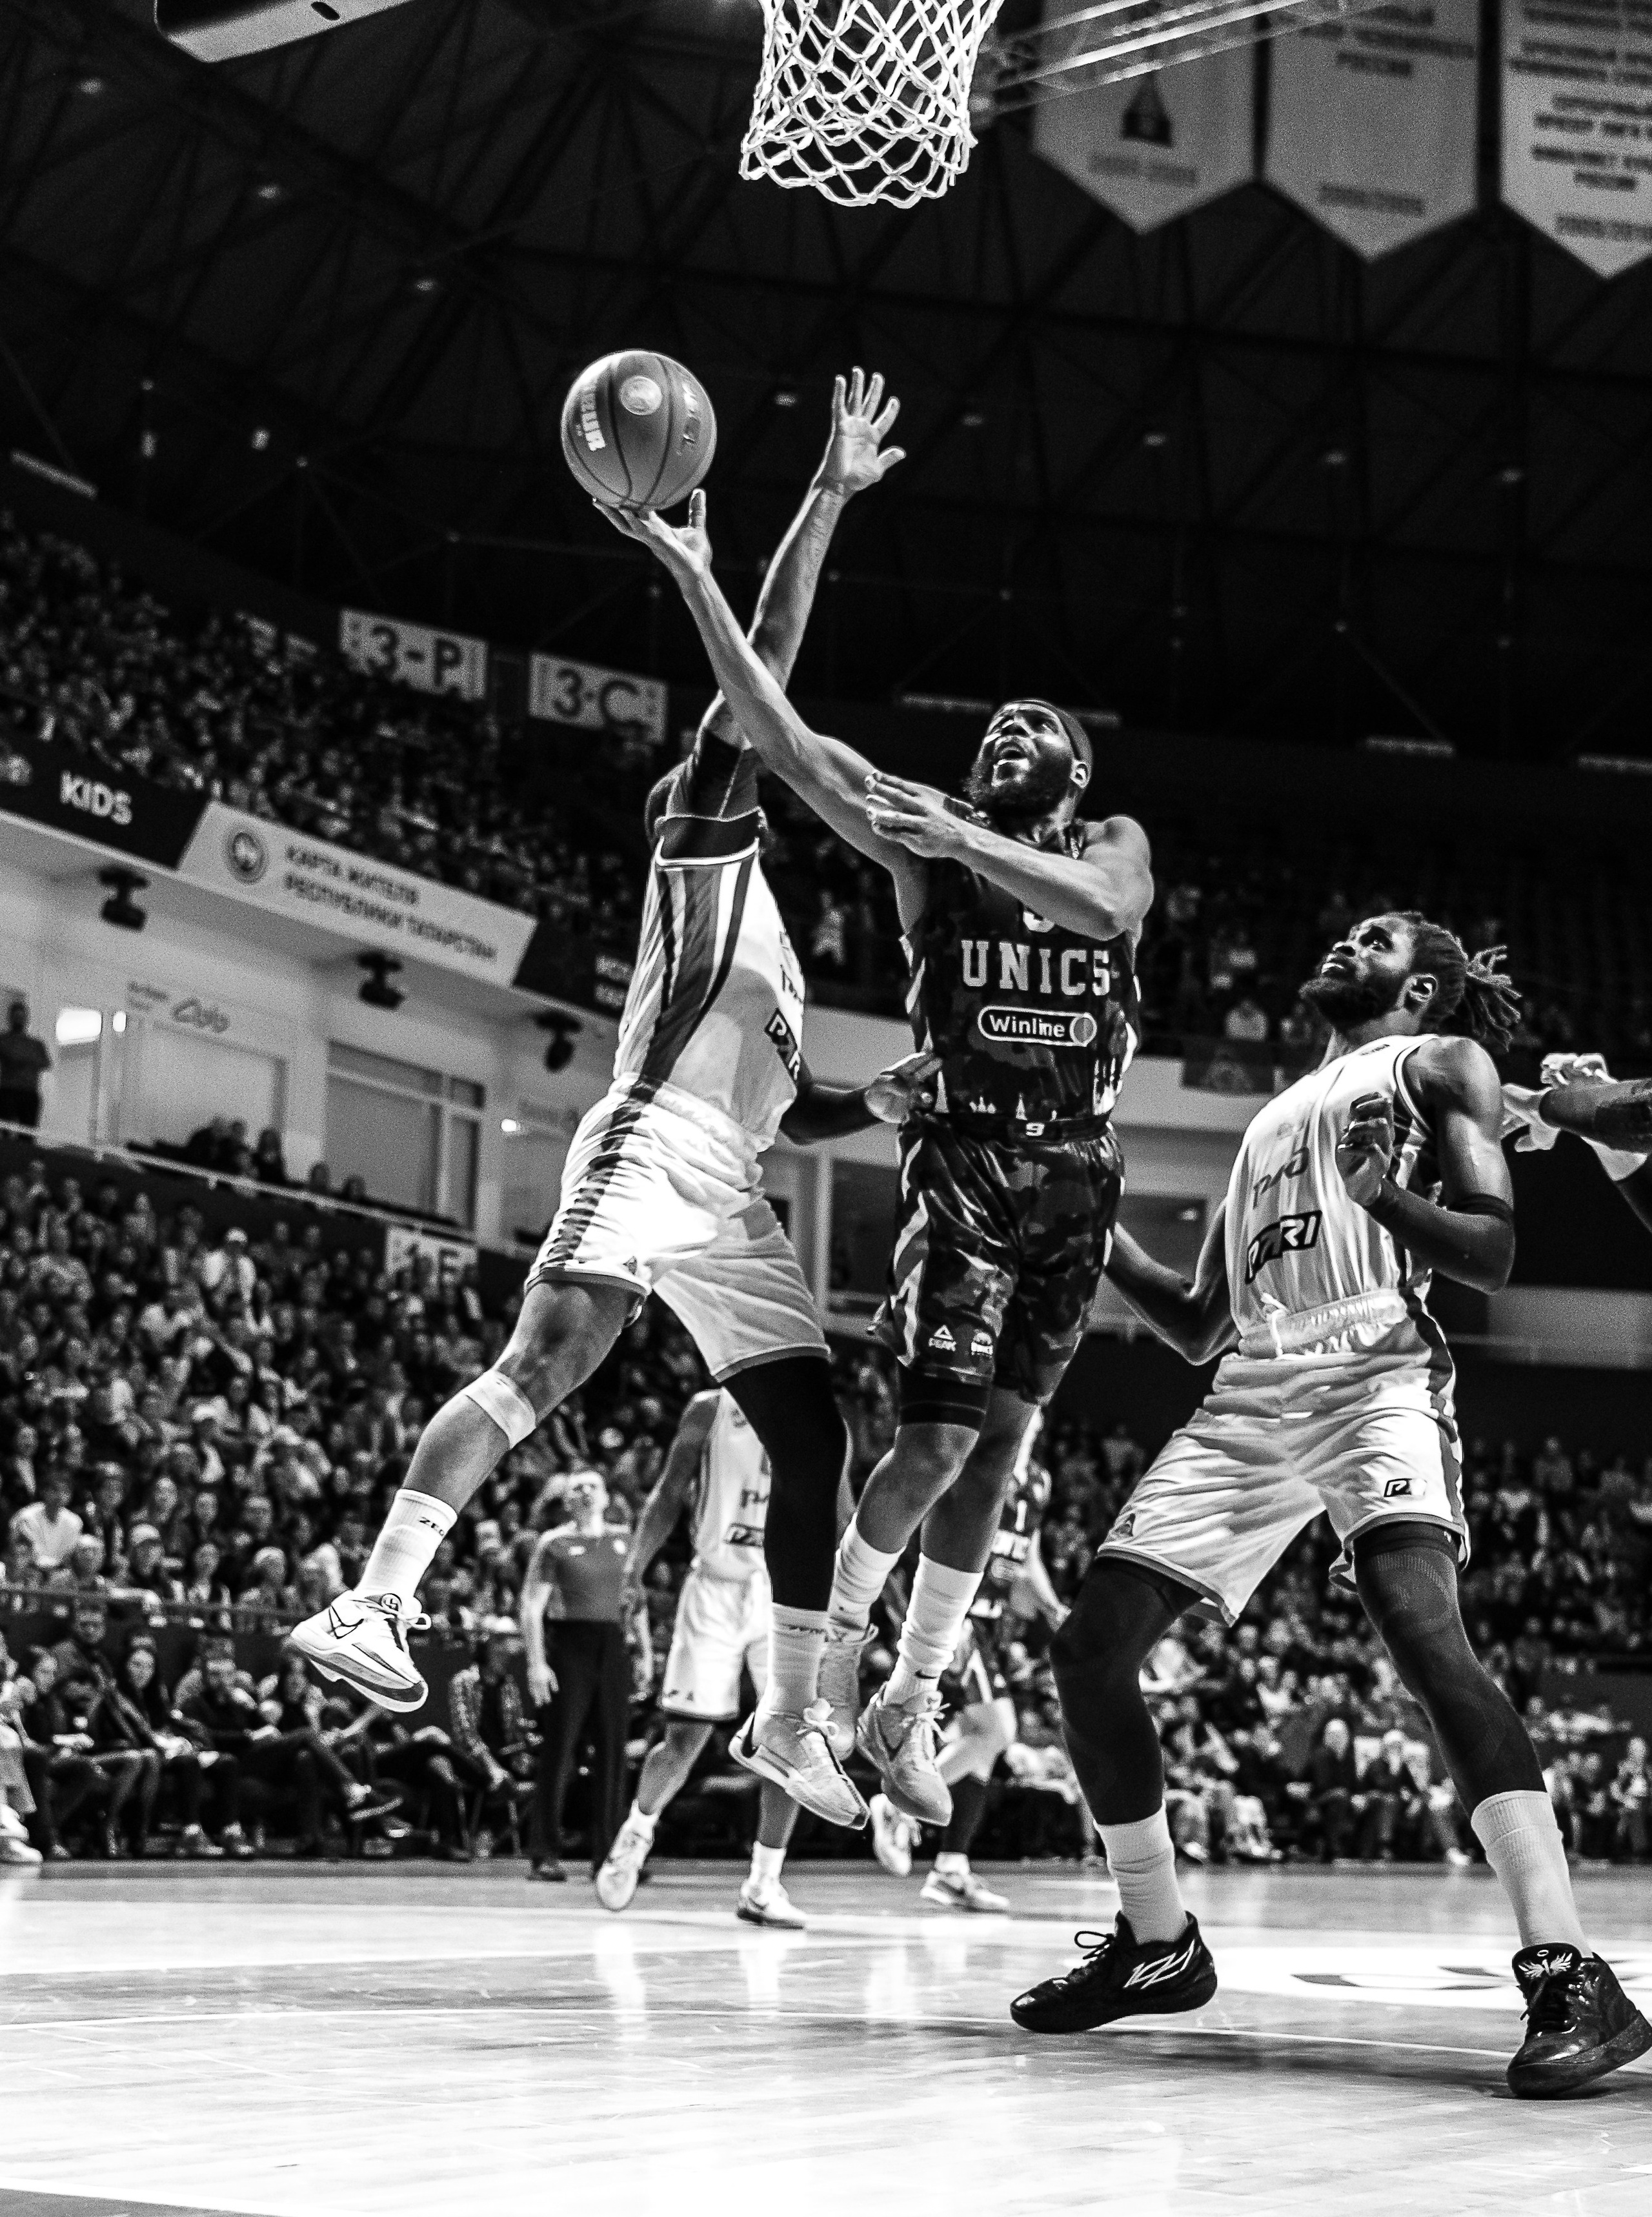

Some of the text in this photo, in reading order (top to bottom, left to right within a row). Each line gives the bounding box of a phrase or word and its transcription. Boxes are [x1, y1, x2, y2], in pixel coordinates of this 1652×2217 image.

[60, 770, 132, 825] KIDS
[962, 940, 1110, 996] UNICS
[989, 1015, 1065, 1038] Winline
[1026, 1123, 1045, 1136] 9
